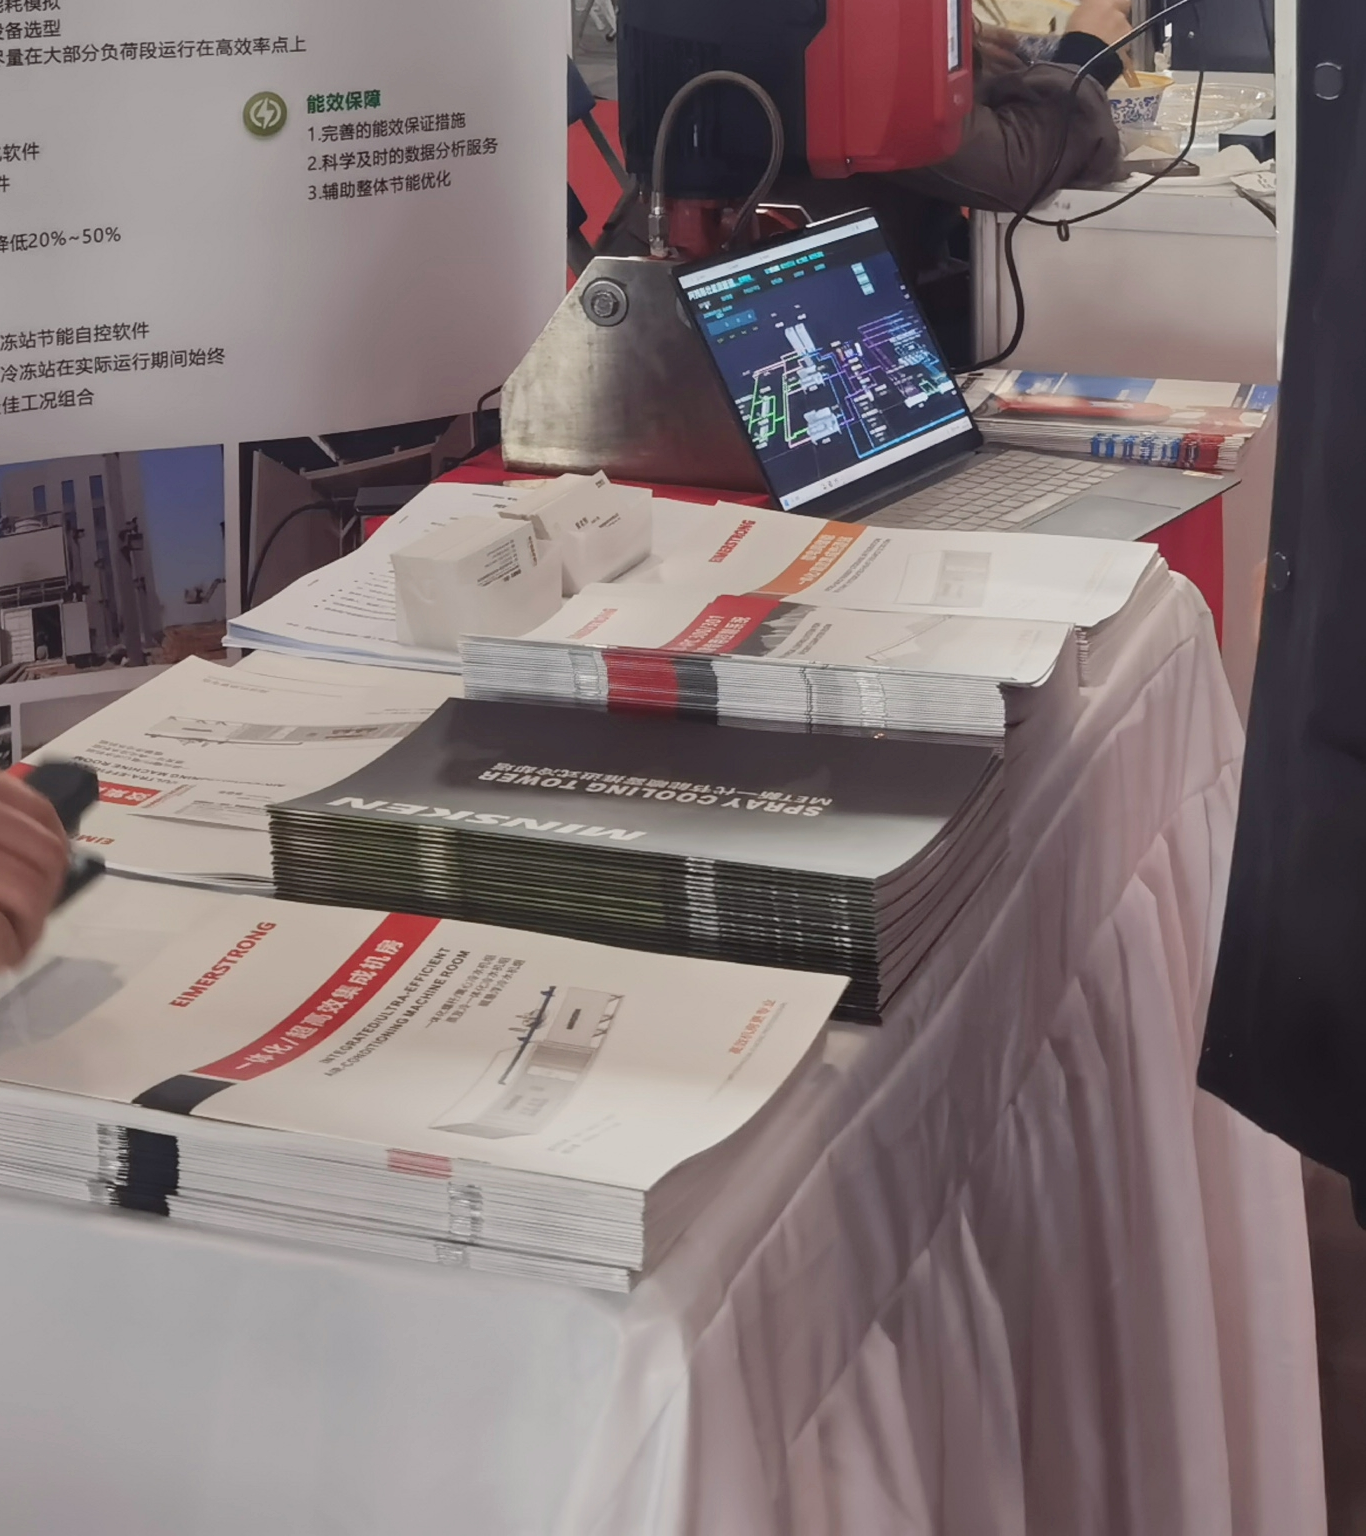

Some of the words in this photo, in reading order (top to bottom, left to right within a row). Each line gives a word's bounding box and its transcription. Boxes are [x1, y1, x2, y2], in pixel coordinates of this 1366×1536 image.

[306, 89, 382, 114] 能效保障
[307, 110, 467, 143] 1.完善的能效保证措施
[307, 136, 499, 173] 2.科学及时的数据分析服务
[307, 169, 452, 203] 3.辅助整体节能优化
[98, 786, 150, 803] 效集
[478, 769, 588, 792] TOWER
[599, 783, 722, 807] COOLING
[327, 796, 648, 842] MINSKEN
[737, 798, 824, 817] SPRAY
[75, 833, 116, 845] EIM
[169, 921, 277, 1008] EIMERSTRONG
[403, 978, 446, 1018] MACHINE
[440, 950, 472, 980] ROOM
[235, 939, 404, 1072] 一体化/超高效集成机房
